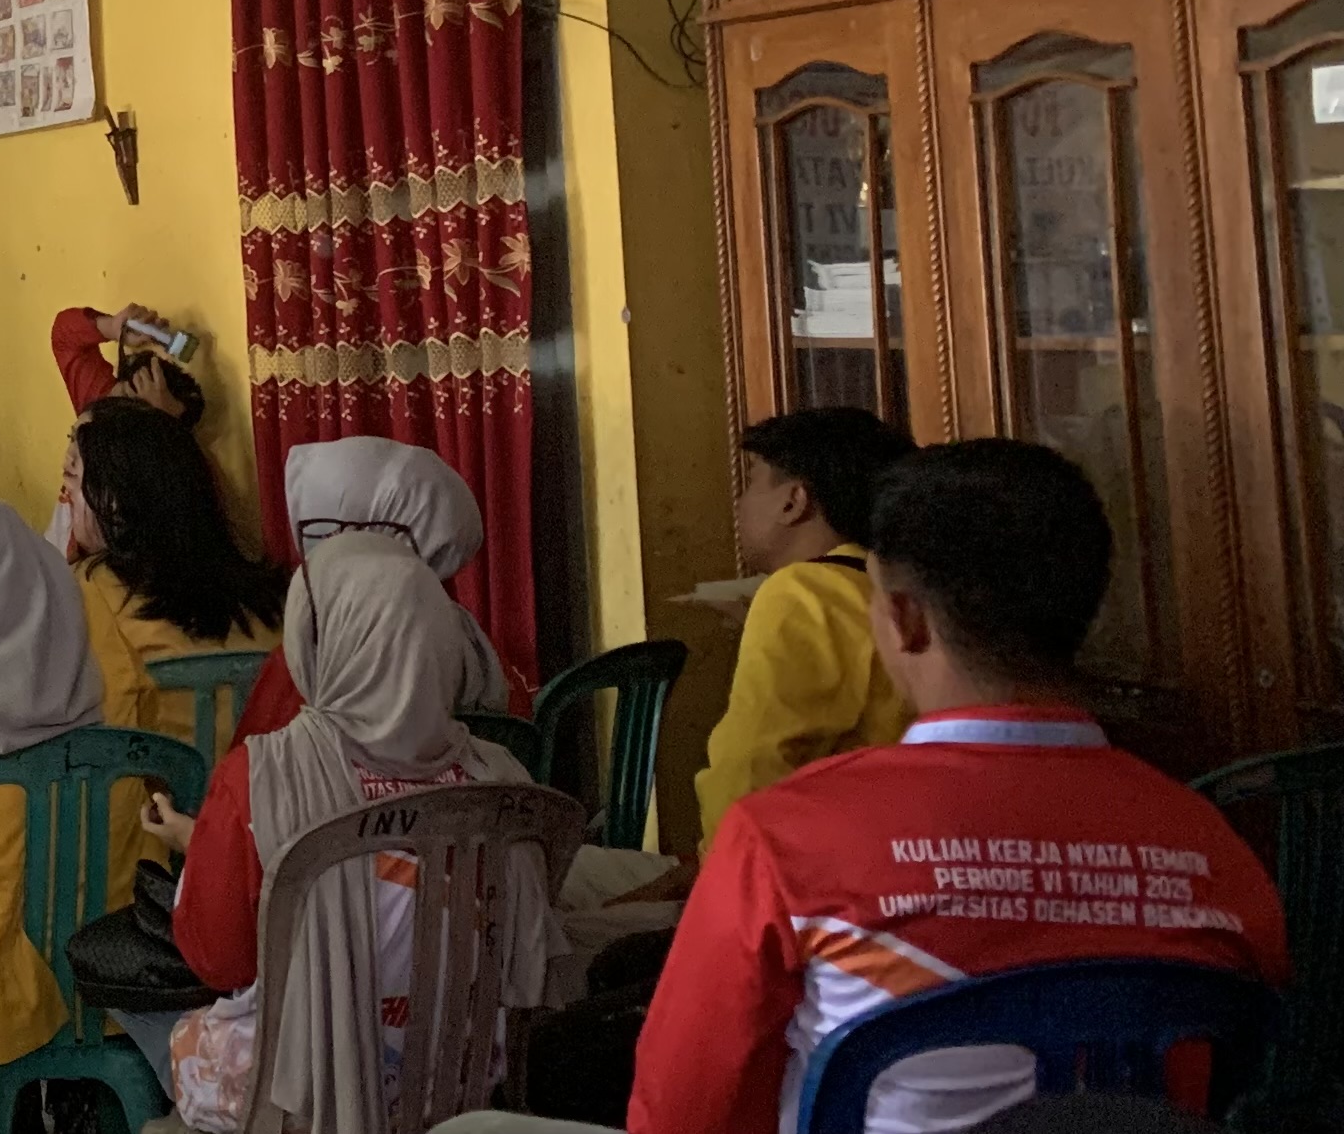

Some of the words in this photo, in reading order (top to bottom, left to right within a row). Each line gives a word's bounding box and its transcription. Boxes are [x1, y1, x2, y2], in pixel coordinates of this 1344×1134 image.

[891, 838, 983, 864] KULIAH
[987, 839, 1063, 866] KERJA
[1066, 841, 1134, 868] NYATA
[933, 867, 1035, 893] PERIODE
[1041, 870, 1062, 894] VI
[1068, 870, 1139, 897] TAHUN
[1145, 874, 1194, 902] 2025
[879, 895, 1029, 922] UNIVERSITAS
[1034, 898, 1137, 926] DEHASEN
